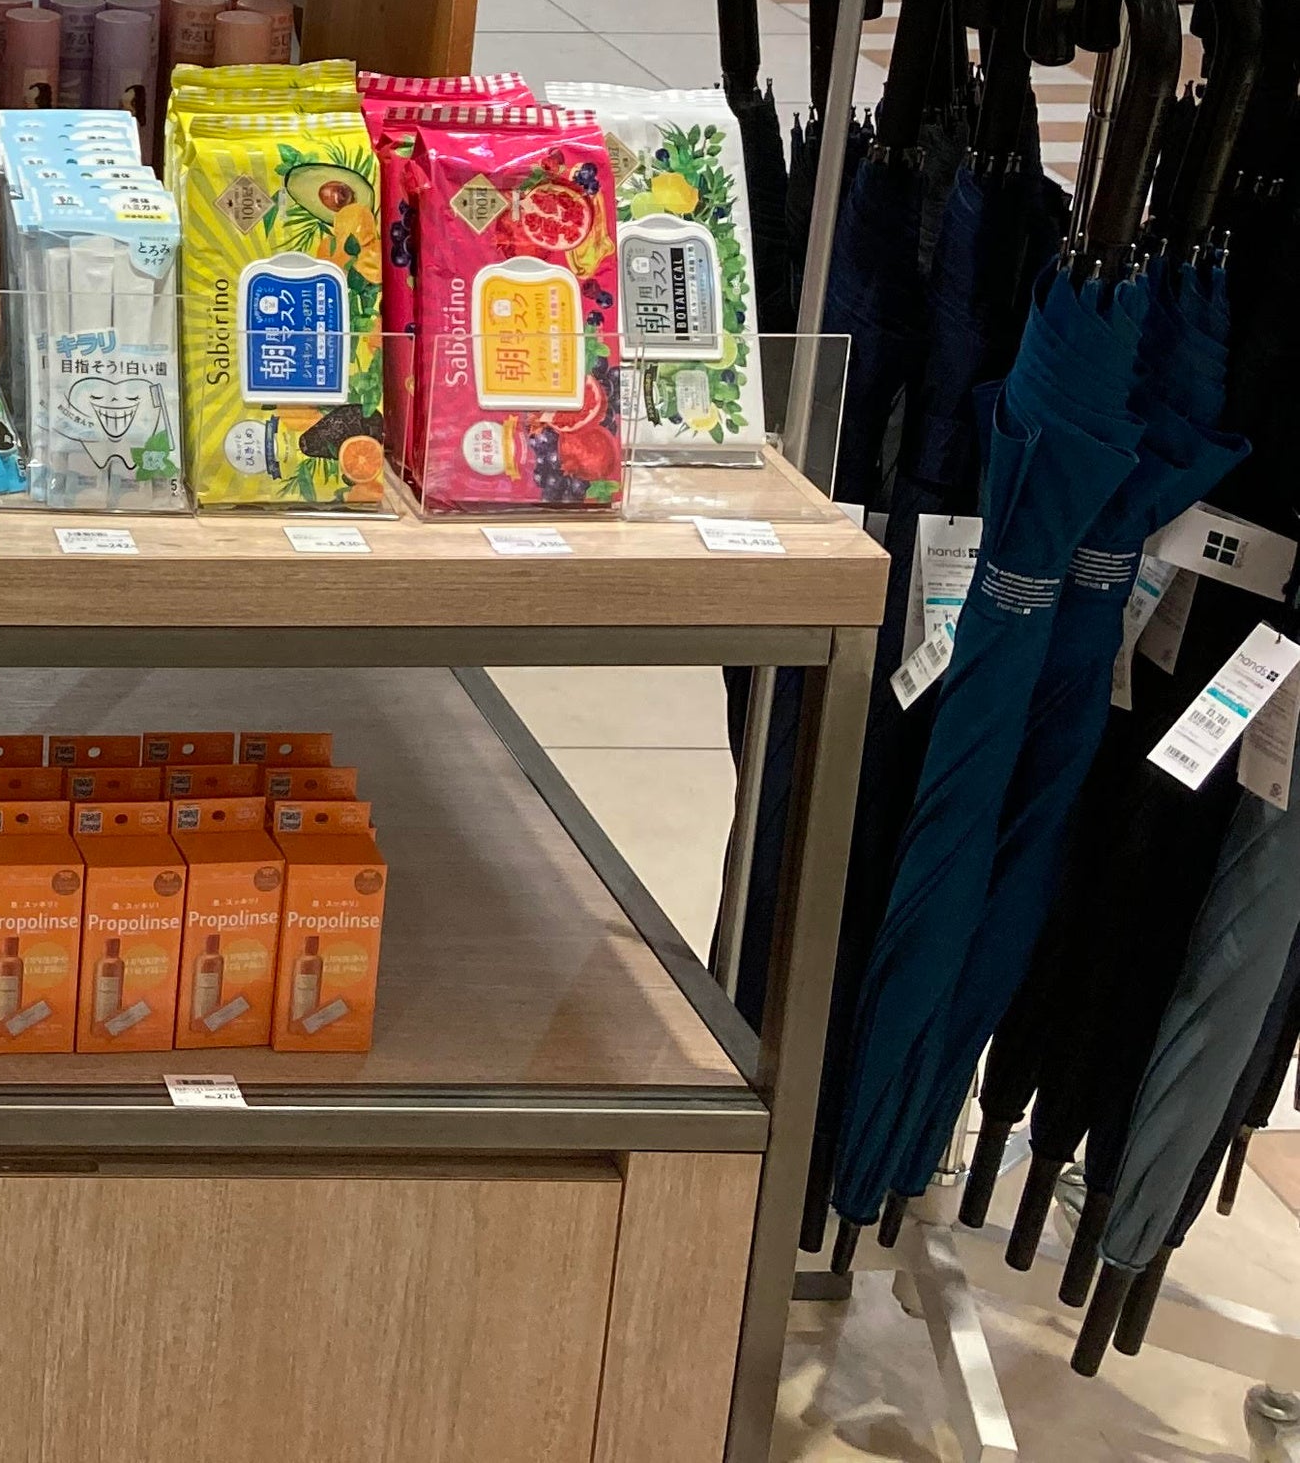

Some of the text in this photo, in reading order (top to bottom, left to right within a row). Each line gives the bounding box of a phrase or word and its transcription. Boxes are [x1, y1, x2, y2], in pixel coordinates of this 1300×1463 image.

[138, 243, 170, 256] とろみ
[676, 258, 688, 330] BOTANICAL
[56, 330, 117, 358] キラリ
[206, 278, 230, 386] Saborino
[443, 278, 468, 386] Saborino
[61, 359, 167, 376] 目指そう!白い歯
[927, 546, 968, 558] hands
[1235, 650, 1270, 681] hands
[88, 914, 180, 936] Propolinse
[188, 909, 279, 933] Propolinse
